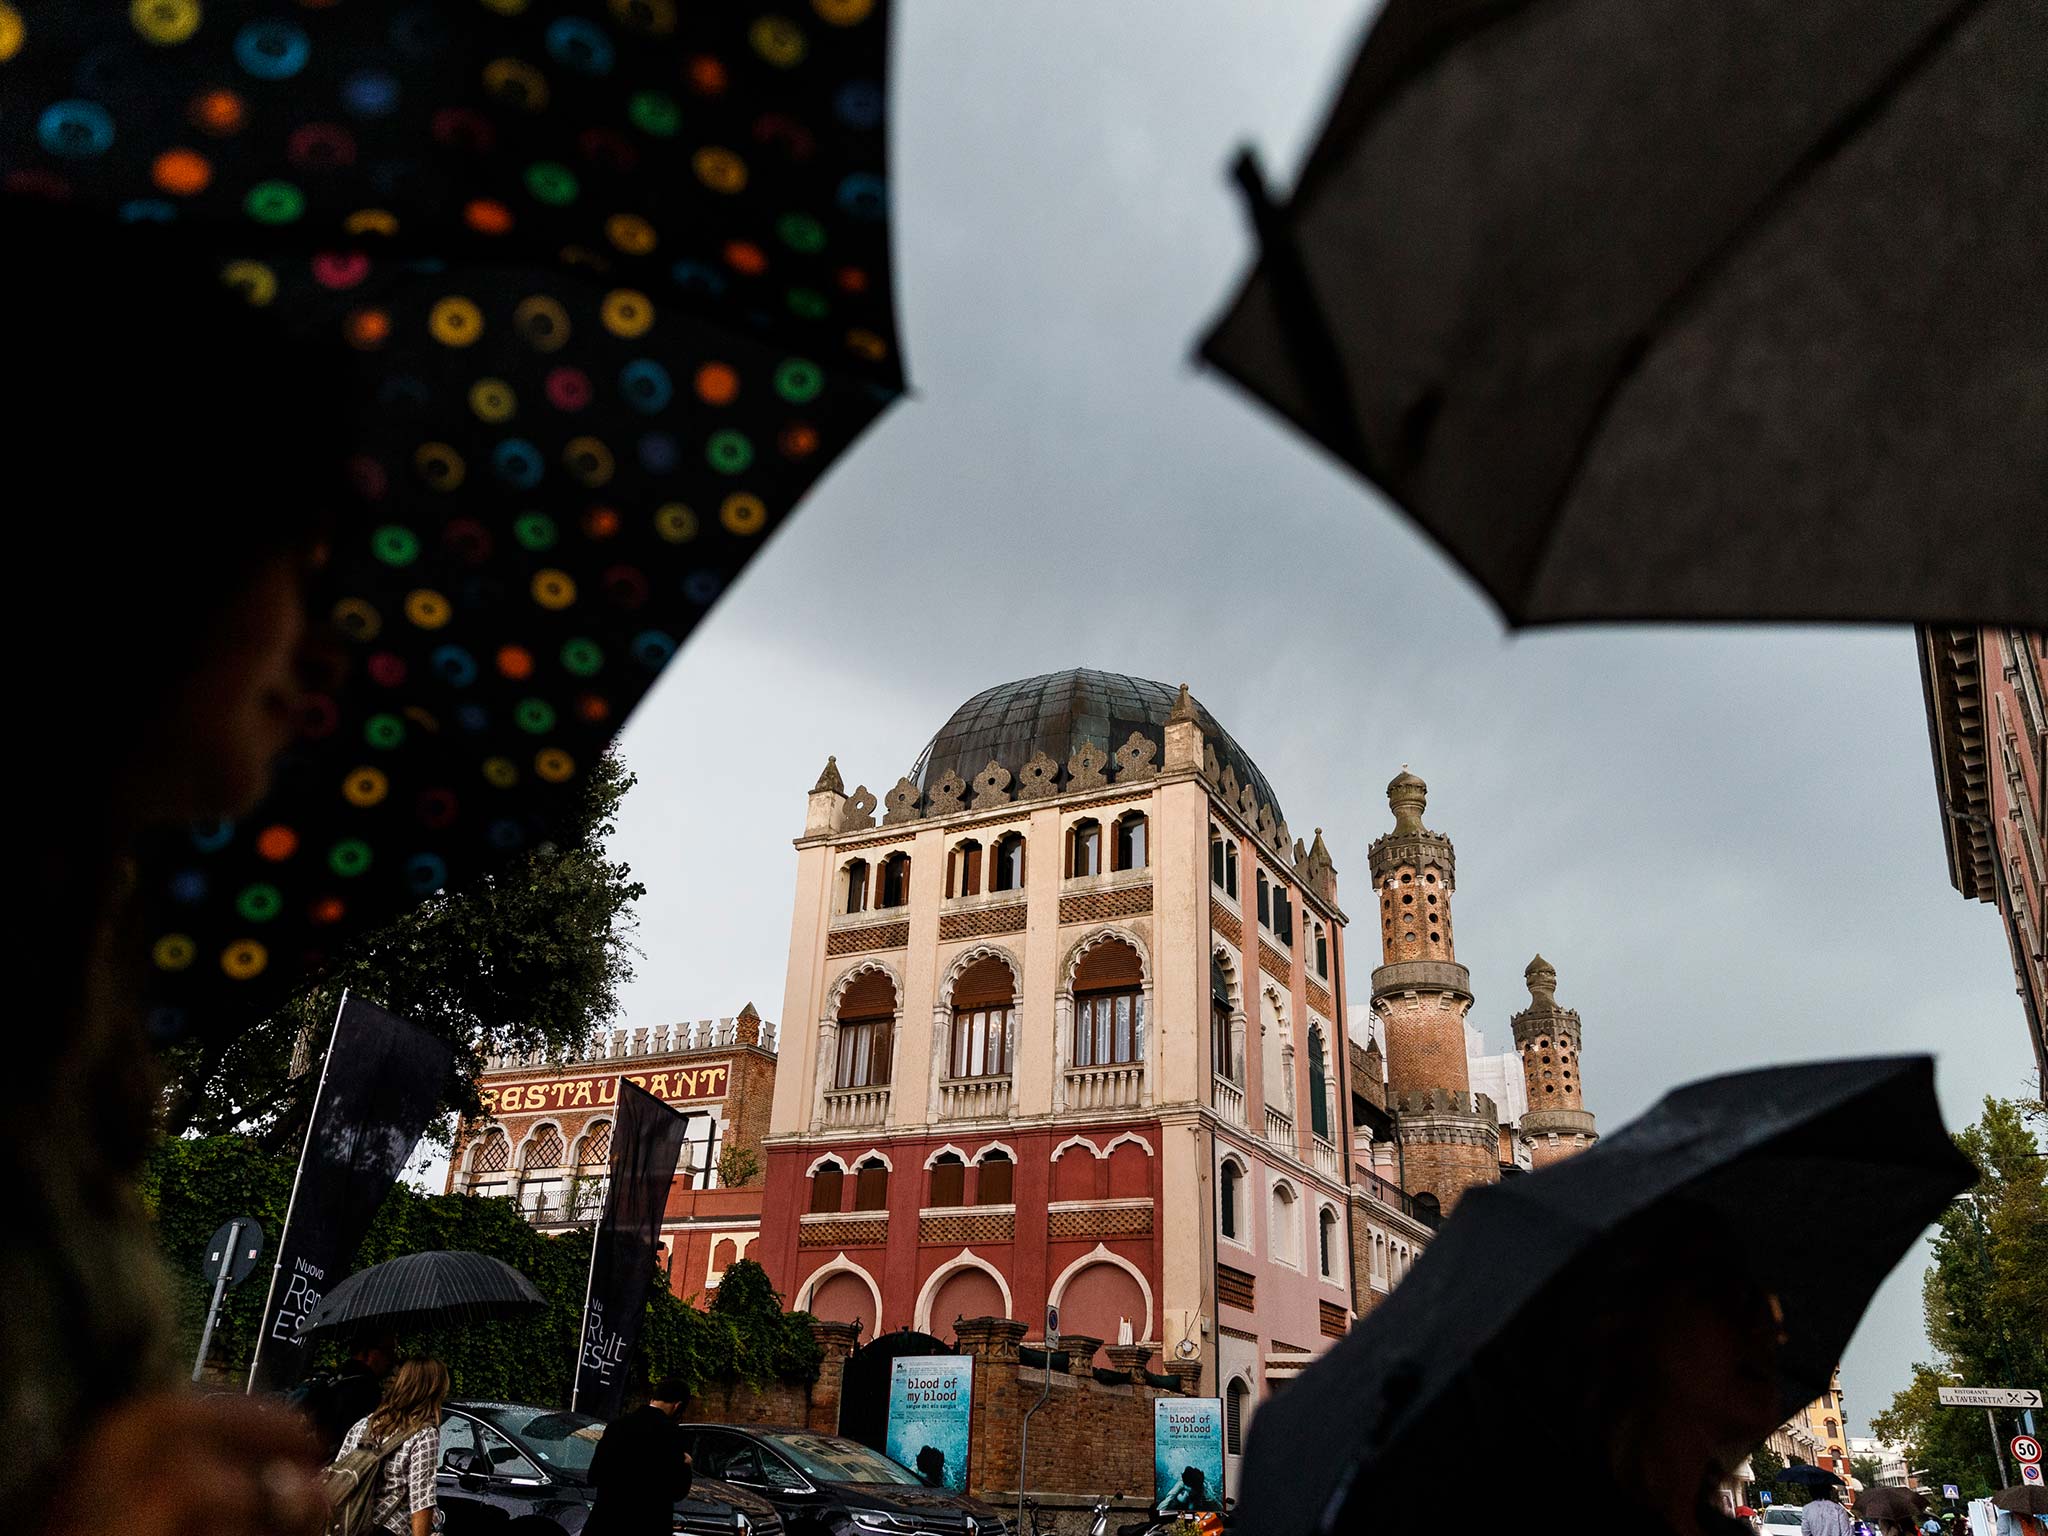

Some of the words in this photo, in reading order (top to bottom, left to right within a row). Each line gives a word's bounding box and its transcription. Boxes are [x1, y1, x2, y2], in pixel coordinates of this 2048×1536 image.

[294, 1256, 325, 1280] Nuovo
[908, 1377, 939, 1389] blood
[944, 1377, 958, 1389] of
[907, 1393, 921, 1404] my
[923, 1390, 957, 1401] blood
[1169, 1414, 1196, 1423] blood
[1199, 1414, 1210, 1423] of
[1169, 1425, 1181, 1434] my
[1183, 1424, 1211, 1433] blood
[2018, 1443, 2036, 1456] 50
